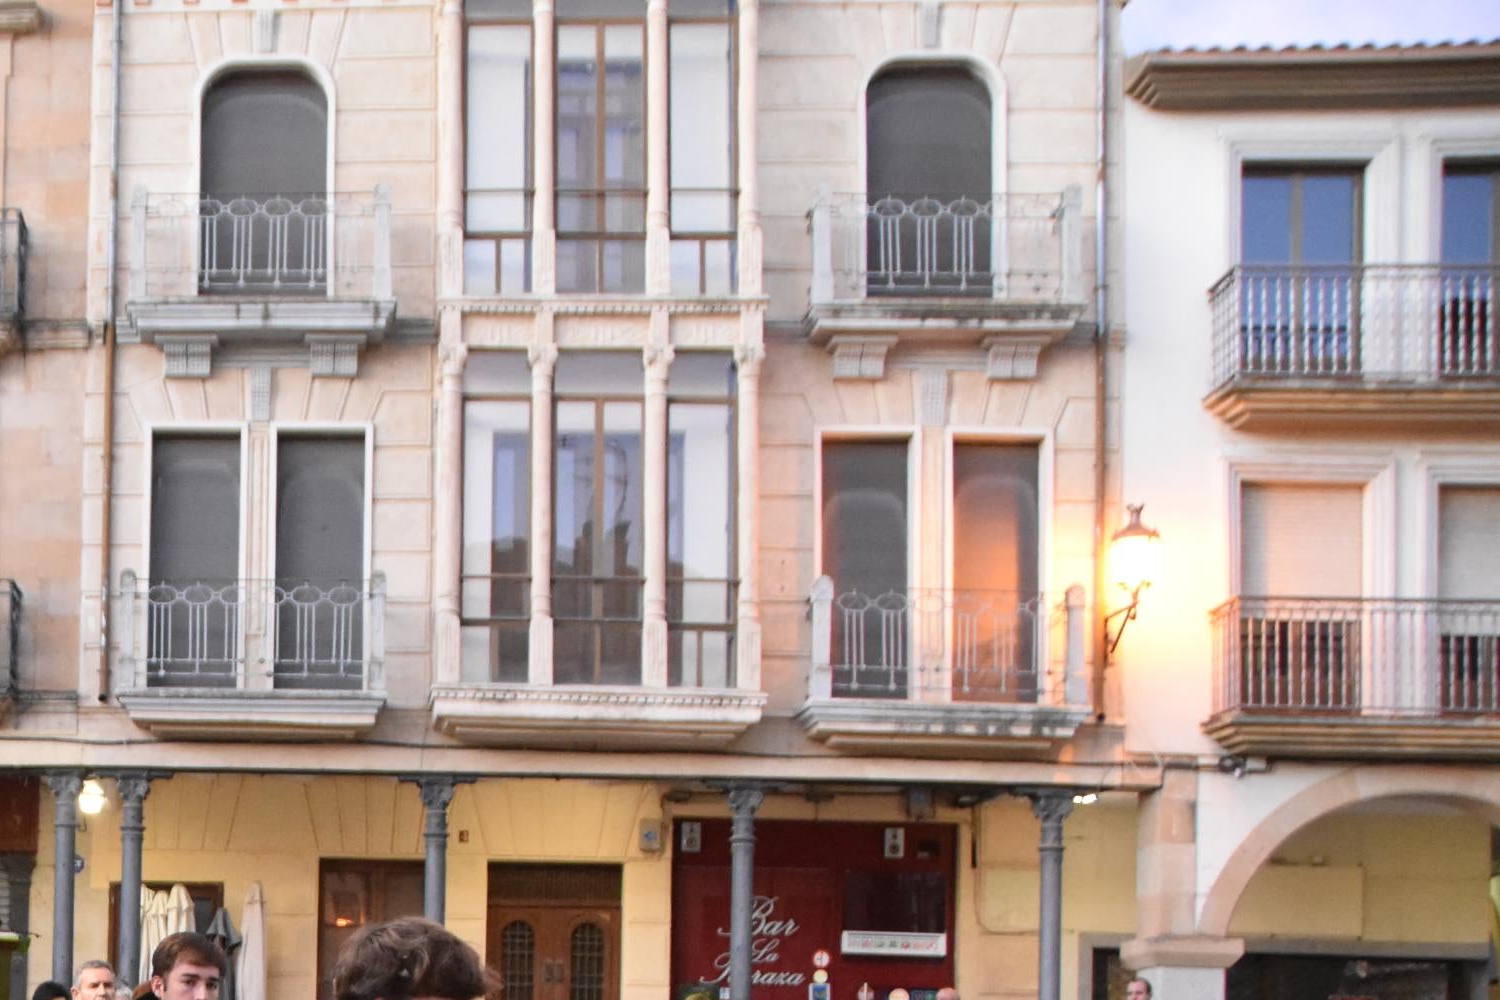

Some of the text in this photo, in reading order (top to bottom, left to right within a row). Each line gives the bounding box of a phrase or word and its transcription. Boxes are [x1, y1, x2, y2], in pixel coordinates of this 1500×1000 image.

[717, 895, 800, 936] Bar
[752, 938, 780, 963] La
[699, 952, 806, 985] Traza
